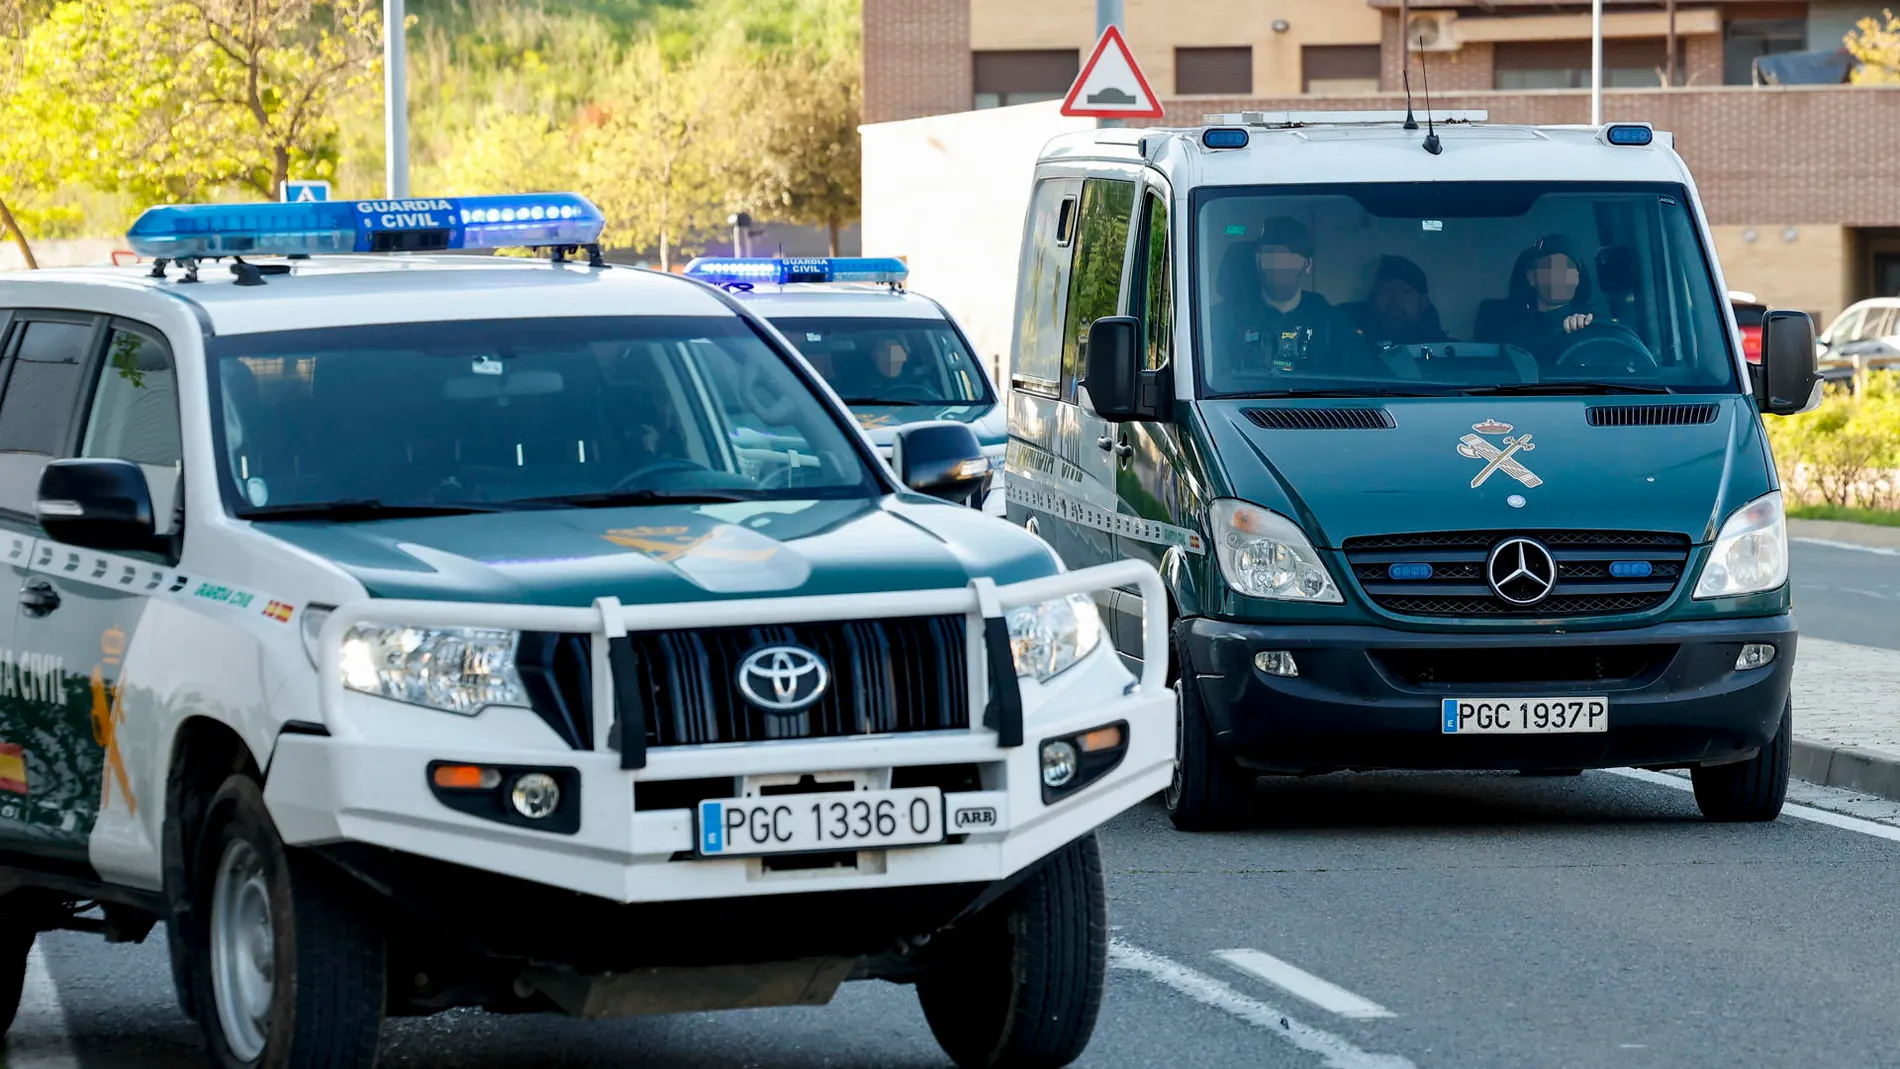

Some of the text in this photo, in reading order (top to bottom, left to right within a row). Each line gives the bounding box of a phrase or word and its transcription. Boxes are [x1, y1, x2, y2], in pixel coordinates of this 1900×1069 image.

[357, 199, 453, 213] GUARDIA
[381, 213, 439, 228] CIVIL
[792, 265, 820, 273] CIVIL
[20, 650, 67, 705] CIVIL
[1459, 702, 1604, 729] PGC 1937 P
[1447, 719, 1454, 728] E
[726, 805, 793, 846] PGC
[811, 799, 897, 841] 1336
[961, 812, 992, 824] ARB
